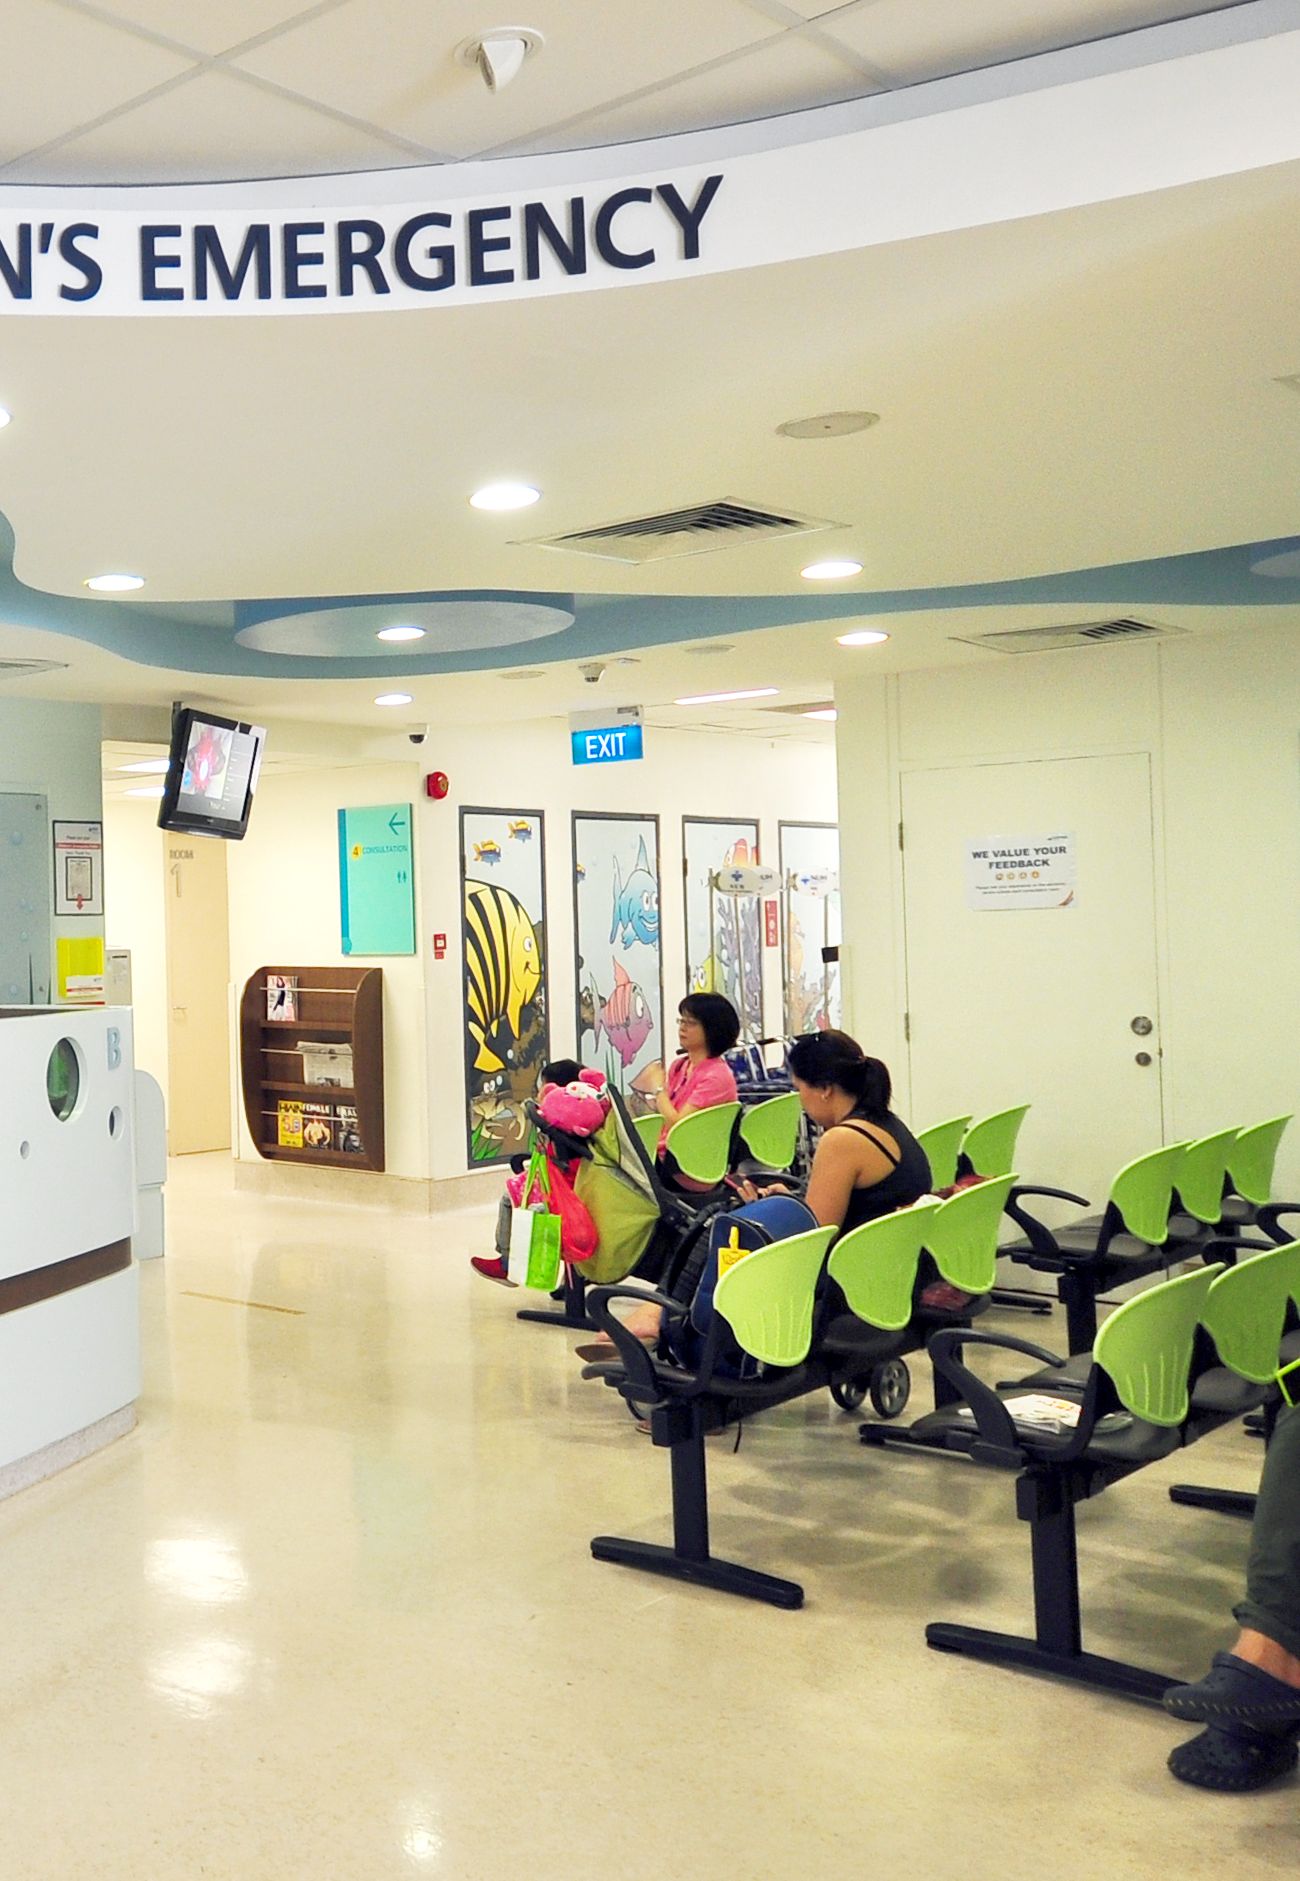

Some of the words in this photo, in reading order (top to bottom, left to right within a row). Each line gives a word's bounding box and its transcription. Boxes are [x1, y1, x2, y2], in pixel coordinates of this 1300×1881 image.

[140, 174, 724, 301] EMERGENCY
[585, 732, 626, 759] EXIT
[169, 849, 194, 859] ROOM
[362, 845, 408, 855] CONSULTATION
[972, 850, 988, 860] WE
[992, 848, 1030, 858] VALUE
[1033, 845, 1067, 855] YOUR
[988, 858, 1050, 870] FEEDBACK
[107, 1027, 121, 1070] B
